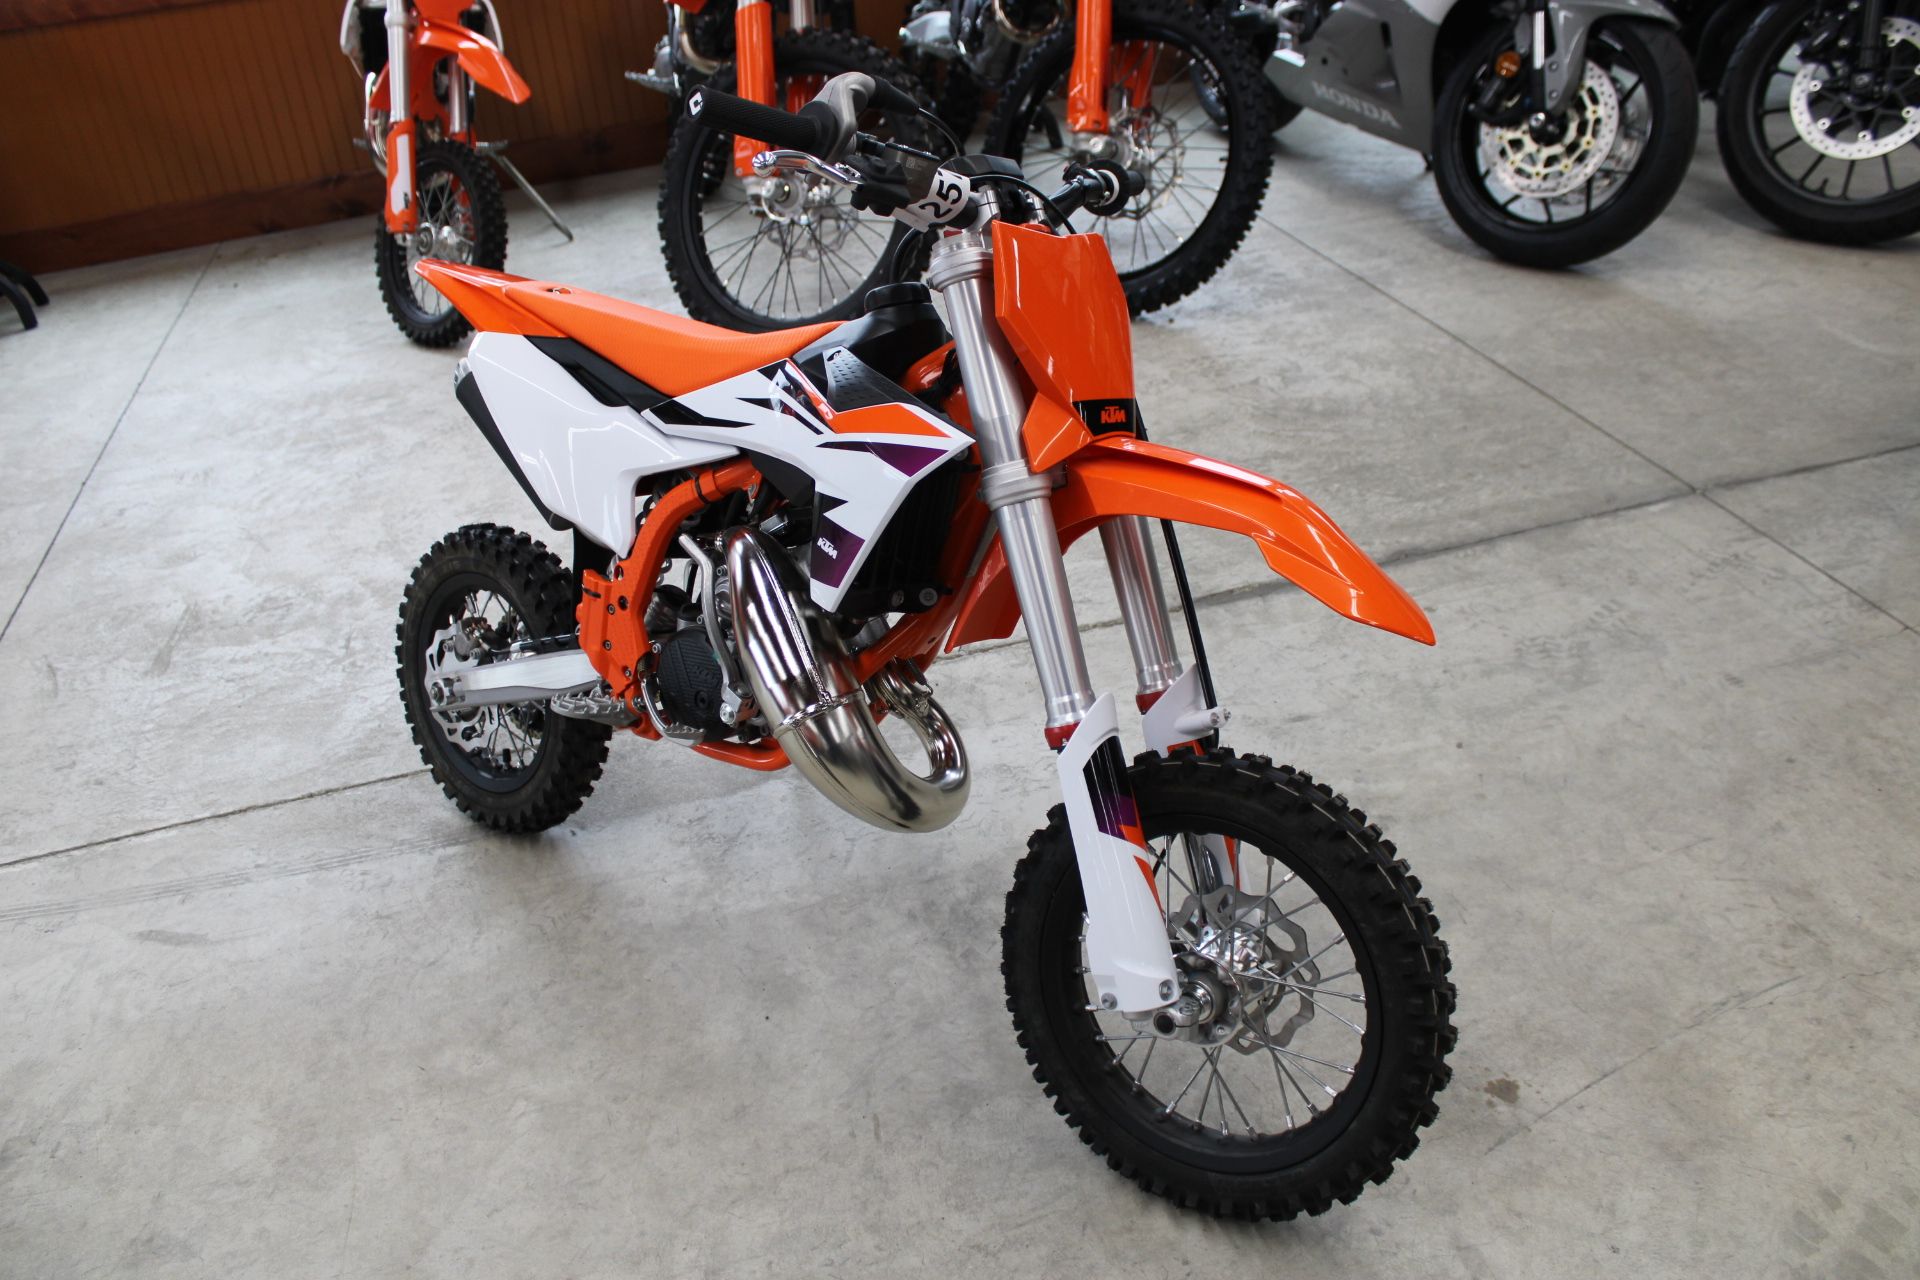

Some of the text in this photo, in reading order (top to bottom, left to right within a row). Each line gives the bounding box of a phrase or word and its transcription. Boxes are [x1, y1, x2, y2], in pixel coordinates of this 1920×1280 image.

[1311, 80, 1402, 129] HONDA
[1101, 405, 1127, 424] KTM
[816, 537, 838, 560] KTM
